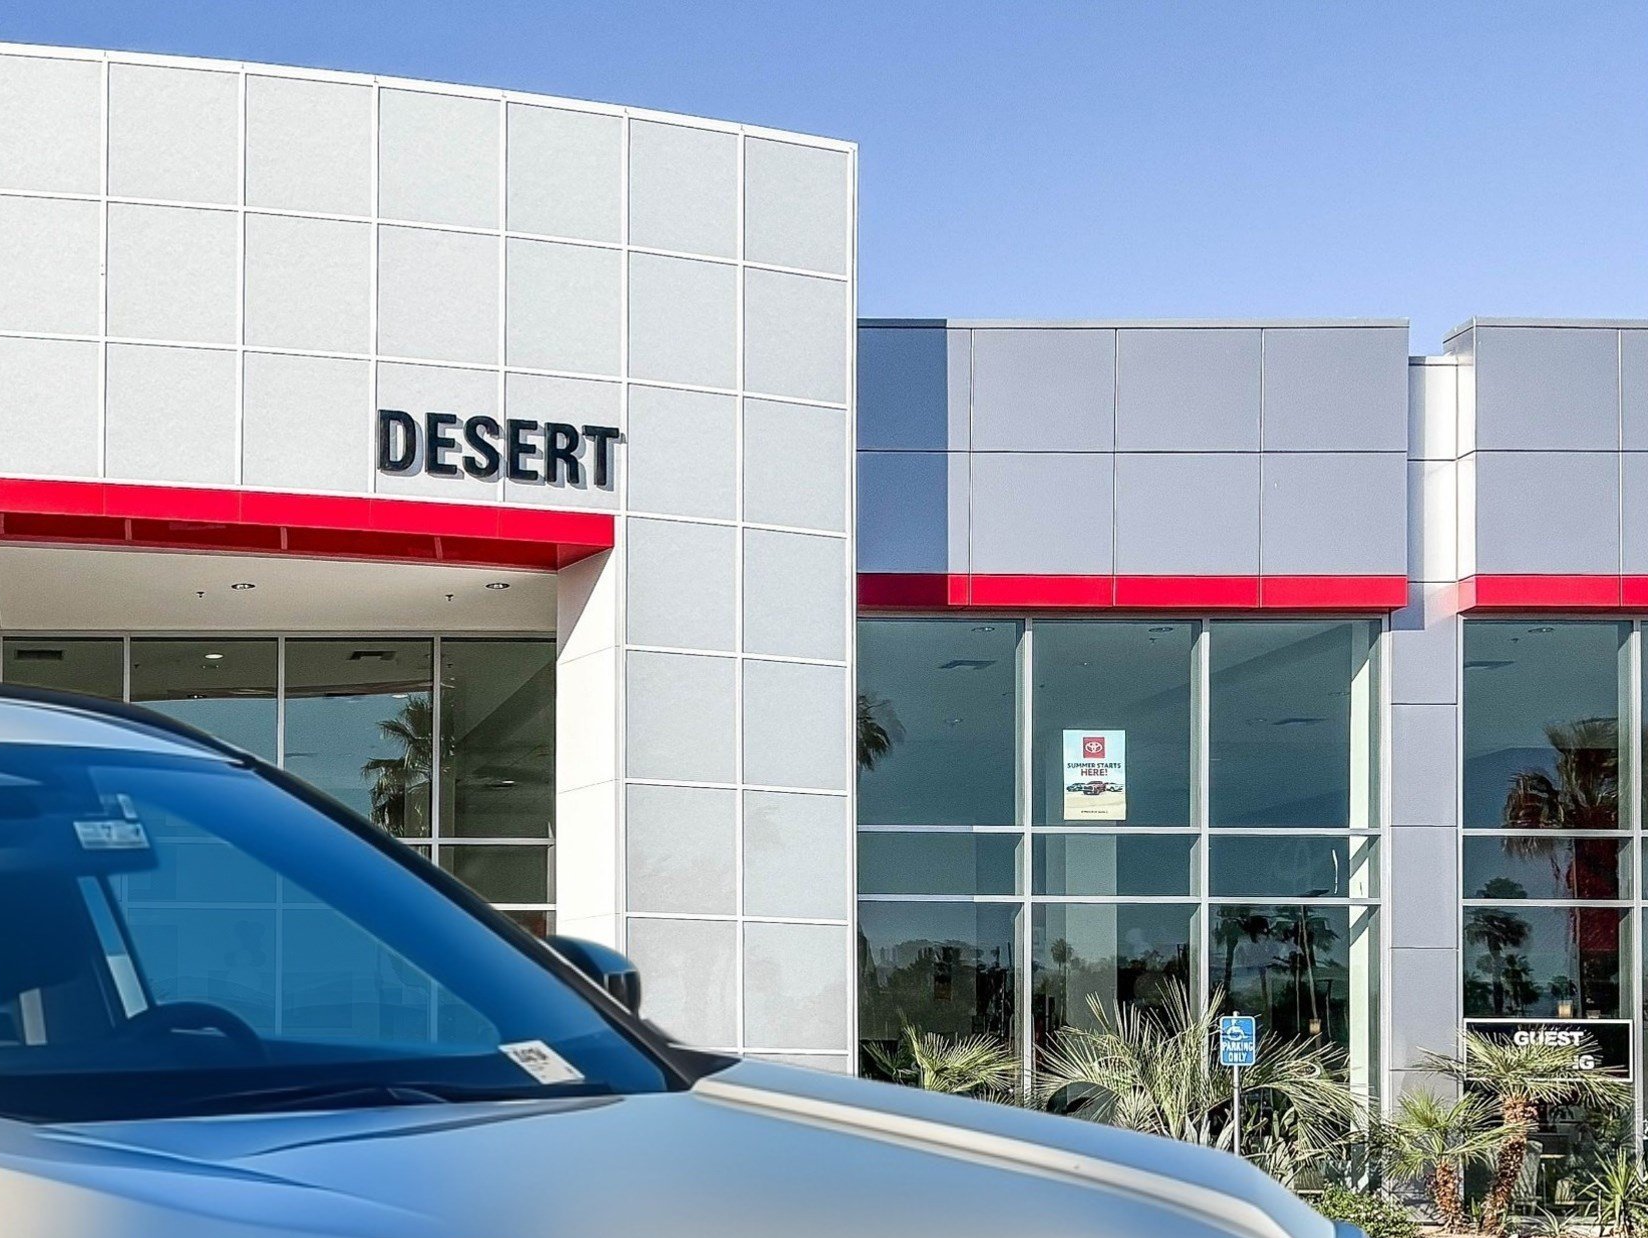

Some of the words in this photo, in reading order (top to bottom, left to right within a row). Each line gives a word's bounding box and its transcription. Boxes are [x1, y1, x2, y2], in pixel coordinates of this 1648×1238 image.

[377, 409, 620, 486] DESERT
[1514, 1031, 1584, 1046] GUEST
[1223, 1041, 1253, 1051] PARKING
[1228, 1052, 1247, 1062] ONLY
